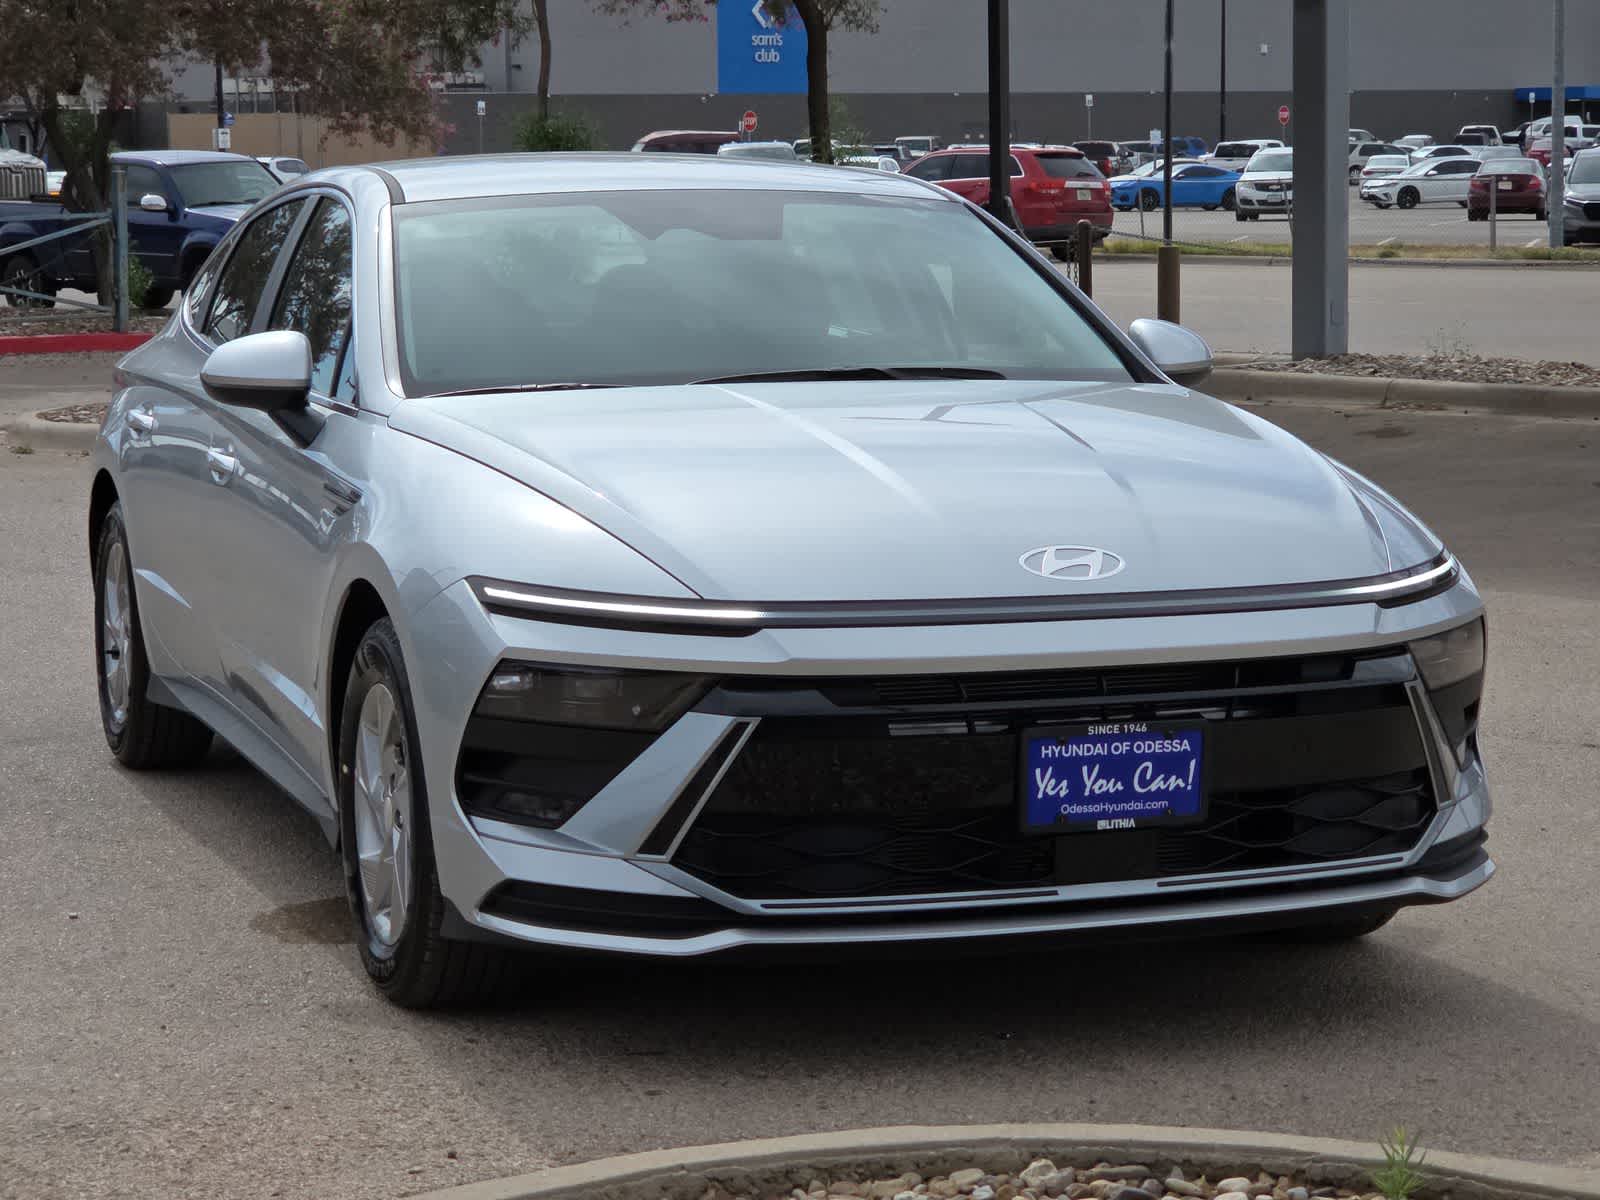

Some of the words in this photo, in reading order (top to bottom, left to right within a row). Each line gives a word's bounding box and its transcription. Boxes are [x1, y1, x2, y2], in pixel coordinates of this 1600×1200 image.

[755, 48, 780, 63] club
[1087, 724, 1120, 735] SINCE
[1124, 723, 1148, 733] 1946
[1041, 743, 1108, 758] HYUNDAI
[1111, 742, 1130, 755] OF
[1133, 739, 1191, 754] ODESSA
[1035, 766, 1069, 800] Yes
[1082, 763, 1124, 796] You
[1133, 758, 1197, 793] Can!
[1061, 800, 1169, 815] OdessaHyundai.com
[1106, 817, 1136, 829] LITHIA
